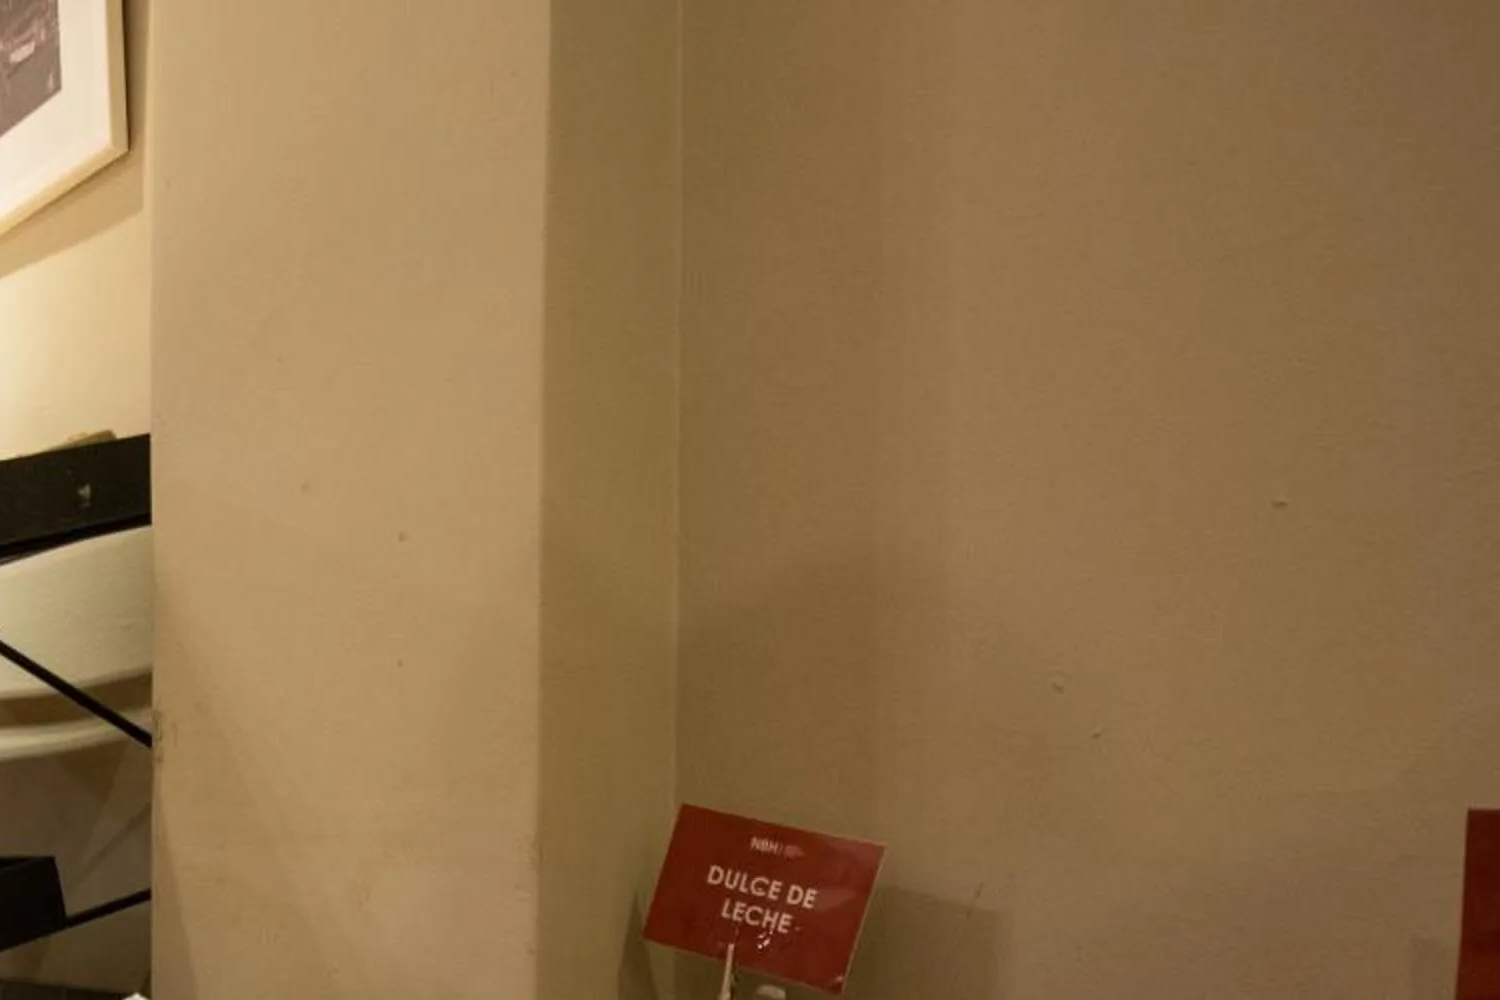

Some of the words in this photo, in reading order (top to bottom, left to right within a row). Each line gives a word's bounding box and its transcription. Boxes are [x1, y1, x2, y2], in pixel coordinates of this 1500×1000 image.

[706, 865, 783, 900] DULCE
[787, 884, 819, 909] DE
[721, 898, 794, 934] LECHE
